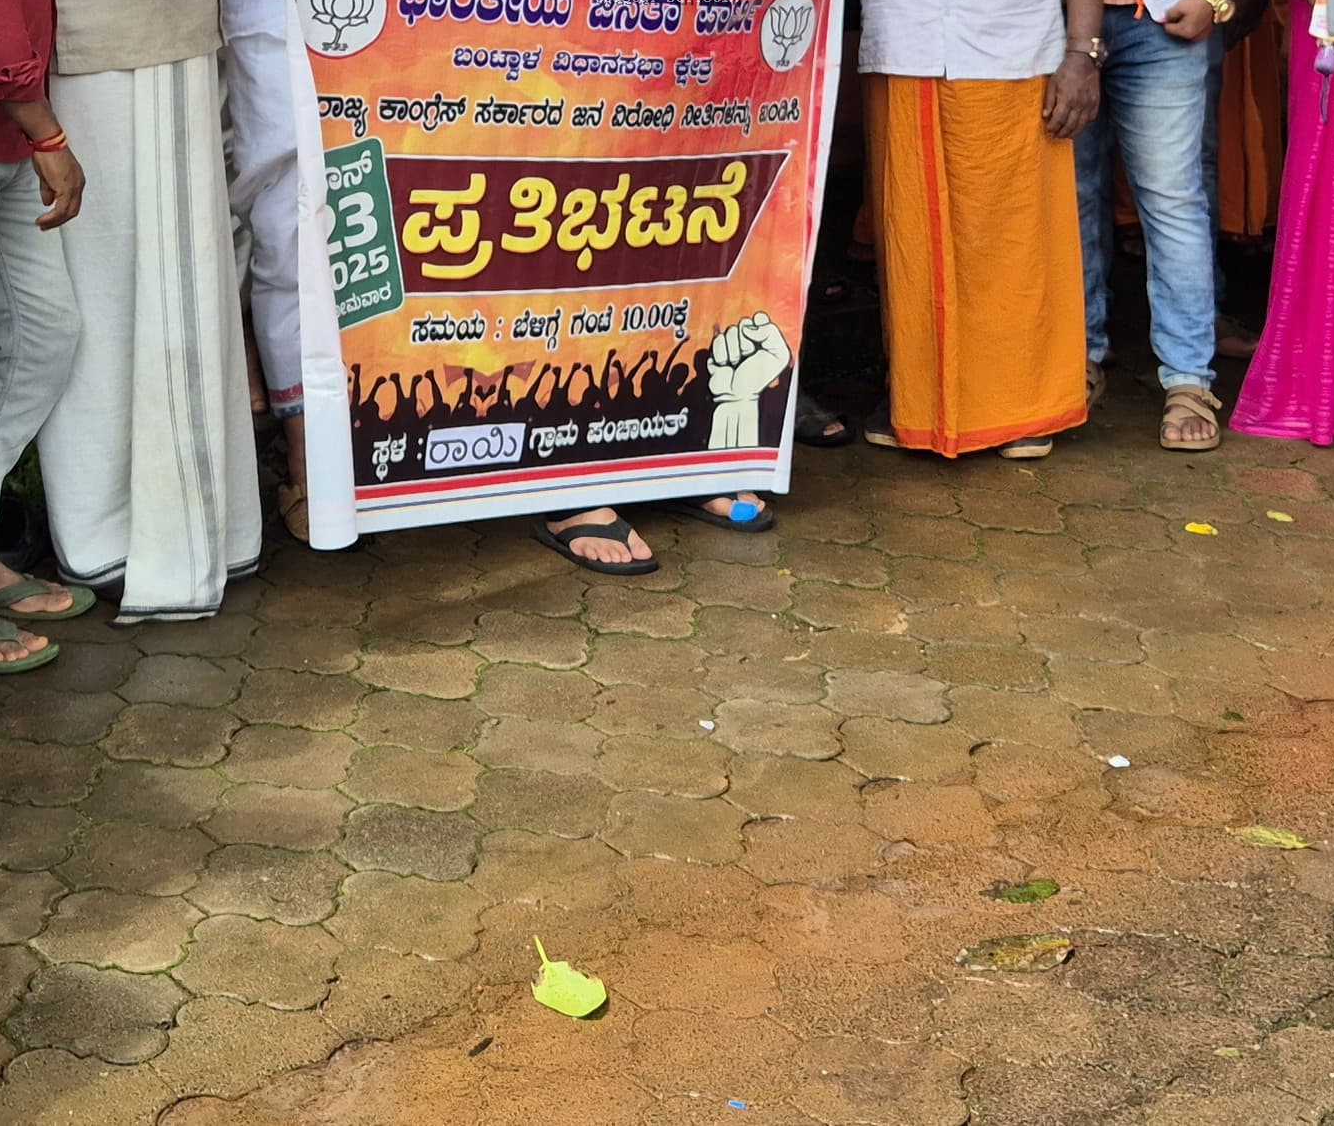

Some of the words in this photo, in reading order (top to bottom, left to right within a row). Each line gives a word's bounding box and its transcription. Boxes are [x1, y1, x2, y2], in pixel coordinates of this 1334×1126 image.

[454, 47, 542, 82] ಬಂಟ್ವಾಳ
[553, 49, 664, 77] ವಿಧಾನಸಭಾ
[675, 51, 715, 85] ಕ್ಷೇತ್ರ
[317, 95, 368, 137] ರಾಜ್ಯ
[379, 93, 466, 131] ಕಾಂಗ್ರೆಸ್
[474, 96, 563, 126] ಸರ್ಕಾರದ
[572, 100, 604, 126] ಜನ
[612, 101, 675, 132] ವಿರೋಧಿ
[402, 161, 747, 279] ಪ್ರತಿಭಟನೆ
[411, 311, 485, 342] ಸಮಯ
[514, 308, 560, 349] ಬೆಳಿಗ್ಗೆ
[571, 306, 612, 335] ಗಂಟೆ
[372, 433, 407, 480] ಸ್ಥಳ
[429, 426, 517, 463] ರಾಯಿ
[529, 421, 579, 457] ಗ್ರಾಮ
[587, 407, 689, 444] ಪಂಚಾಯತ್
